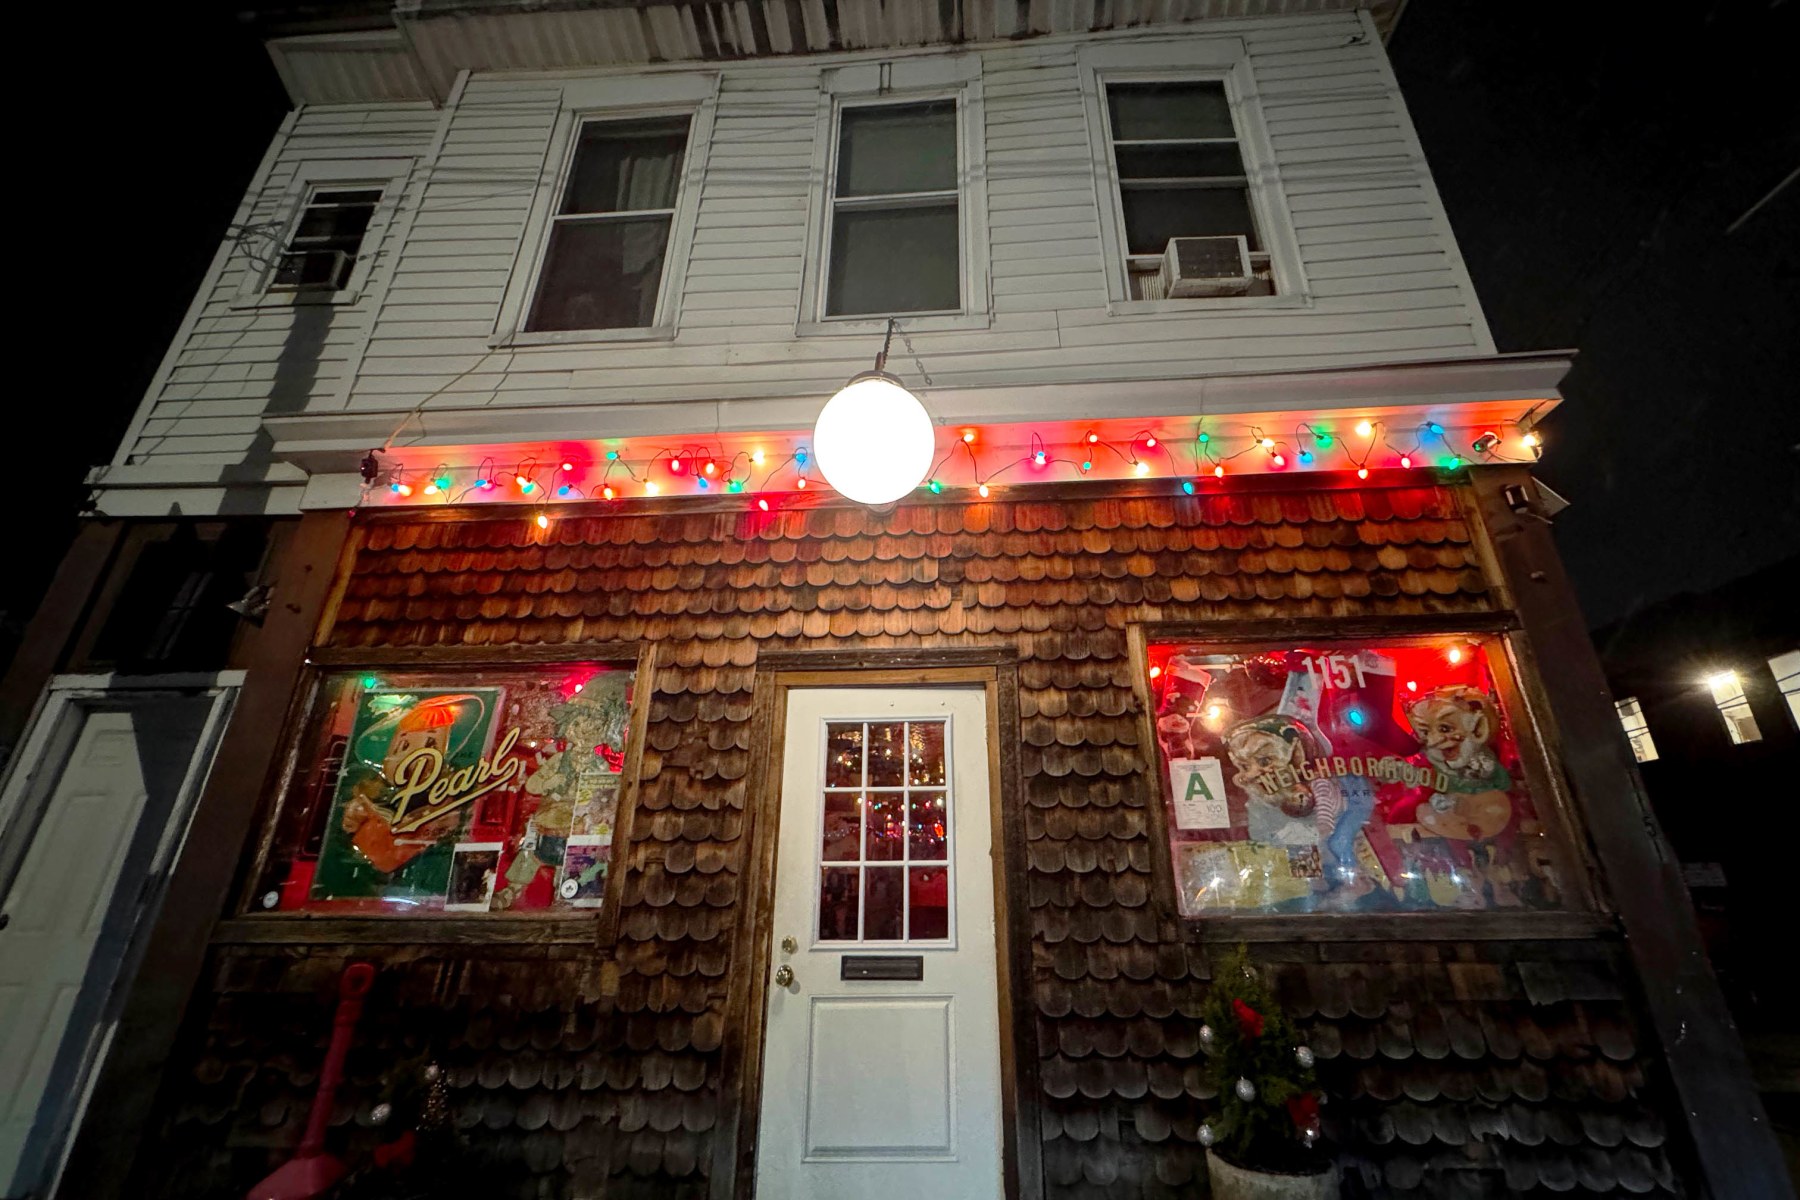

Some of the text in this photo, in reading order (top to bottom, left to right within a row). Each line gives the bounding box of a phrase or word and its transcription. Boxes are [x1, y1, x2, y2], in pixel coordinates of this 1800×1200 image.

[1301, 654, 1367, 689] 1151
[389, 726, 520, 834] Pearl
[1185, 772, 1215, 801] A
[1258, 756, 1450, 794] NEIGHBORHOOD
